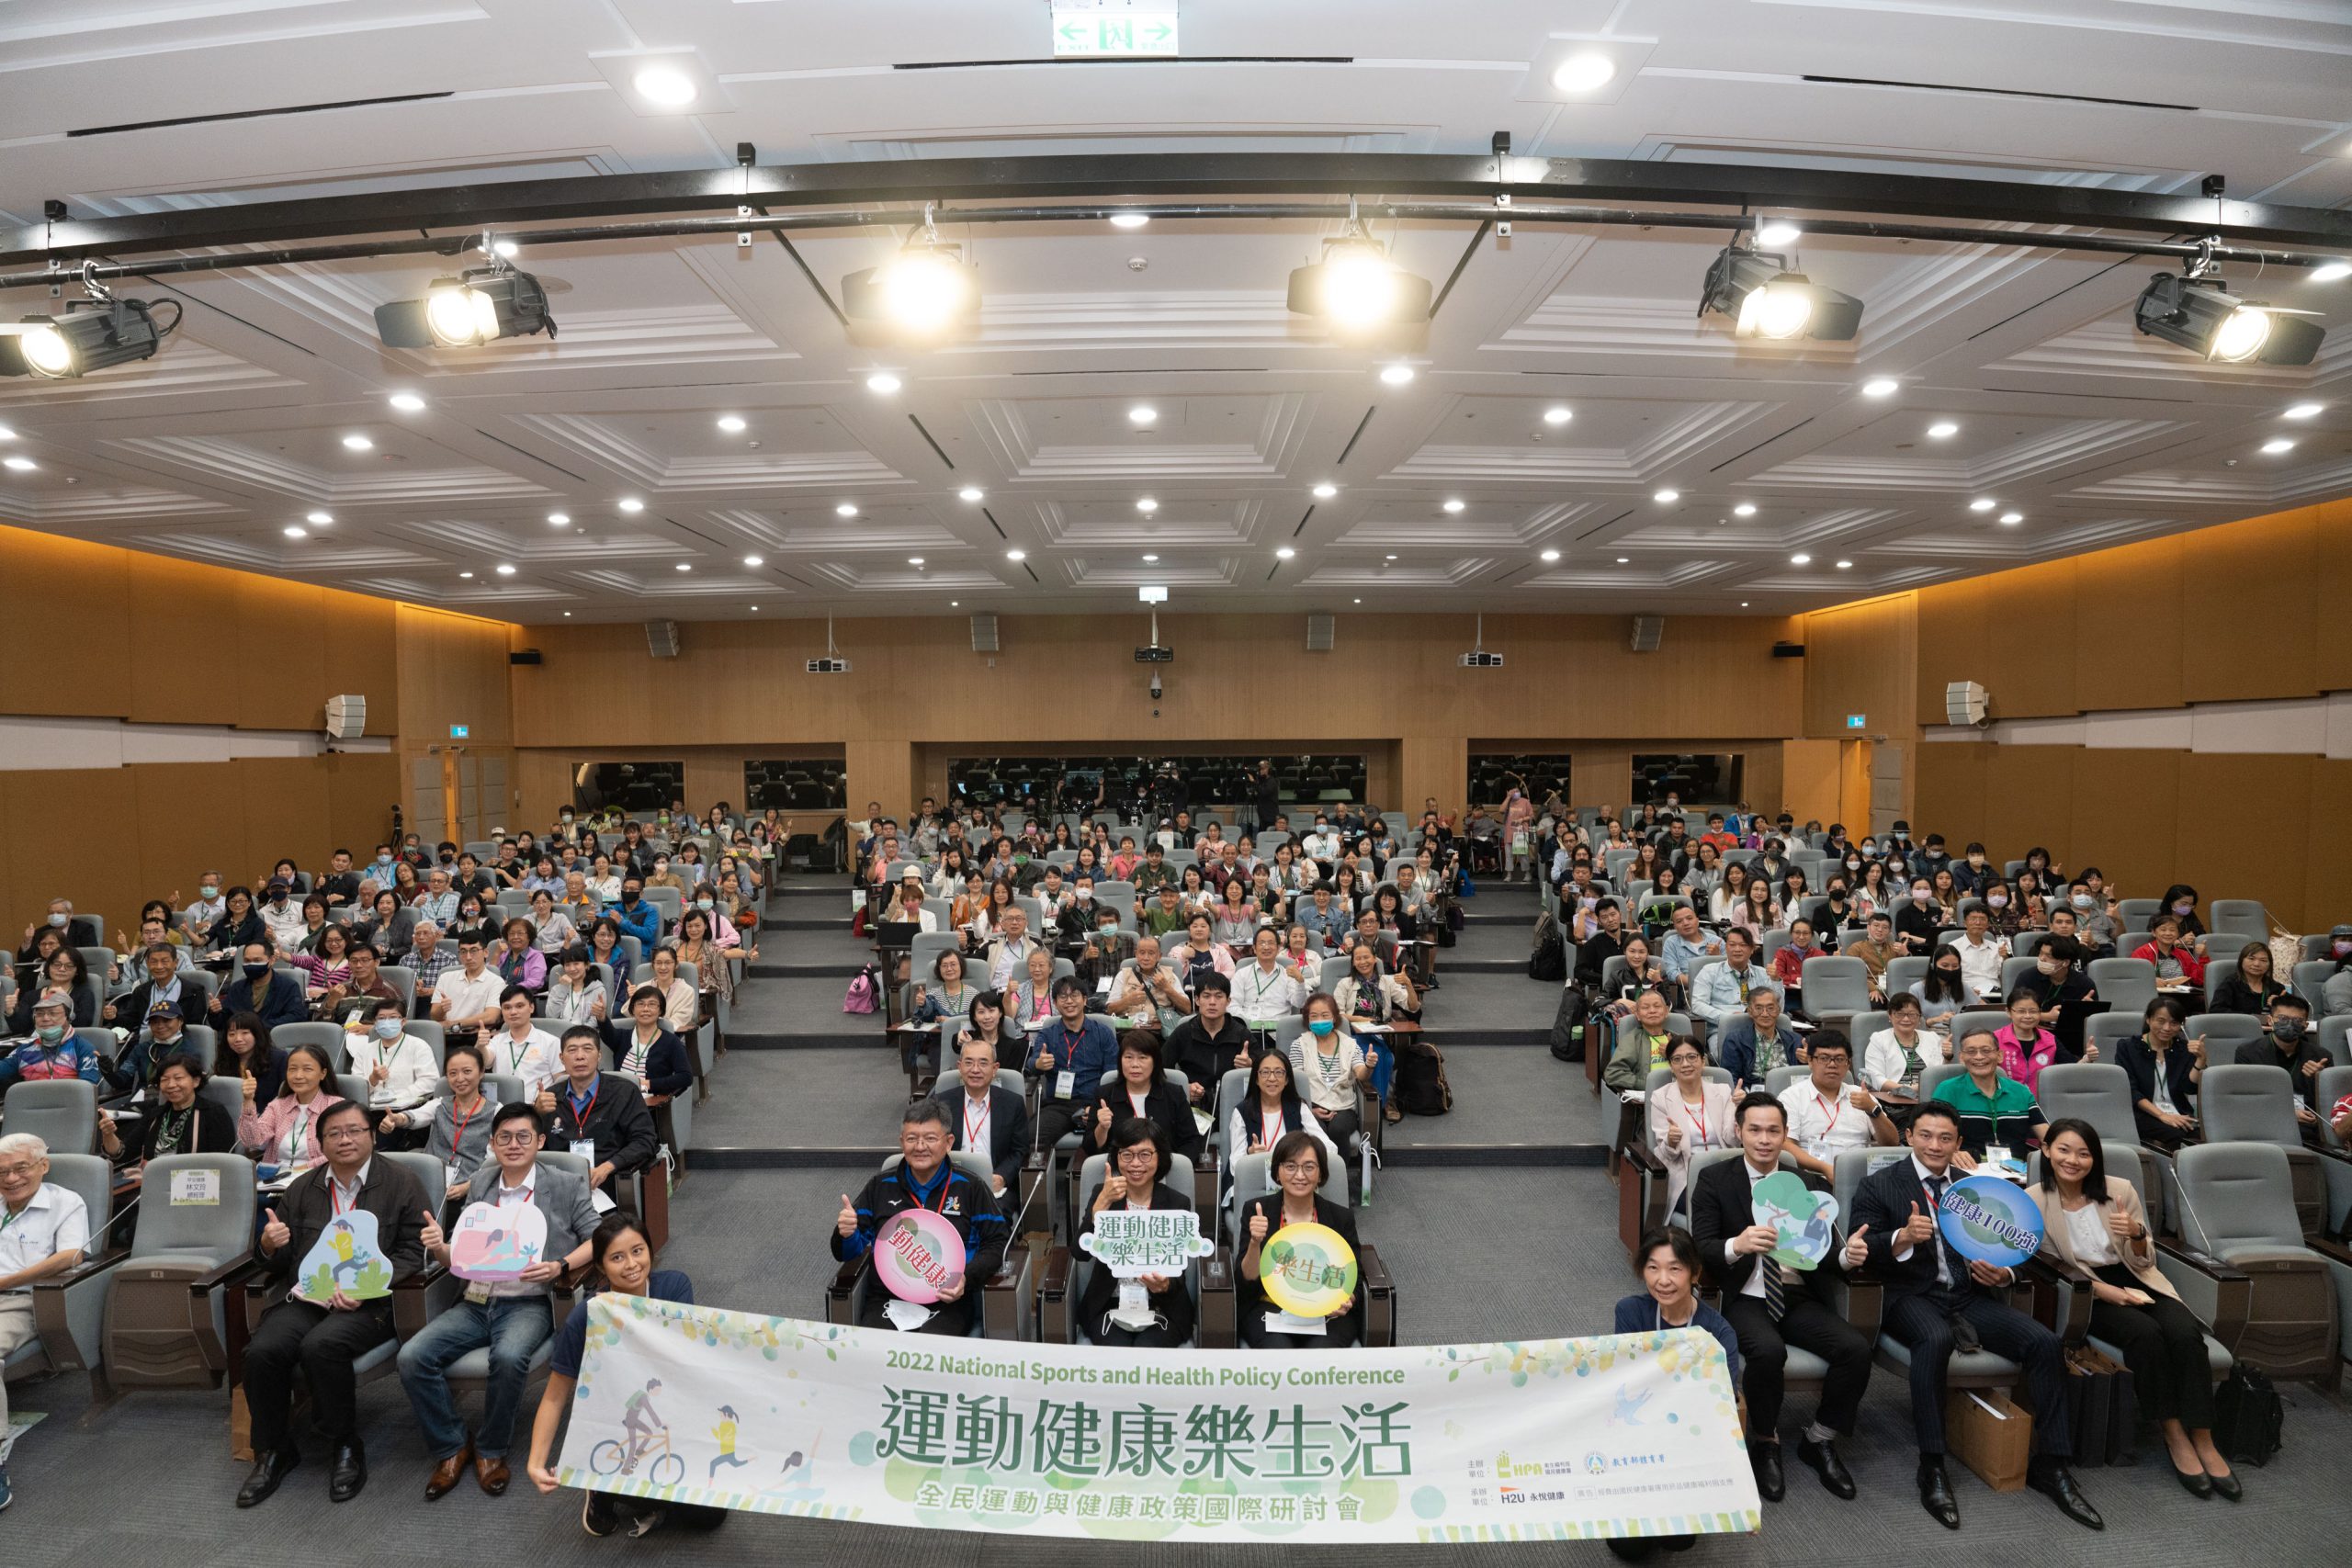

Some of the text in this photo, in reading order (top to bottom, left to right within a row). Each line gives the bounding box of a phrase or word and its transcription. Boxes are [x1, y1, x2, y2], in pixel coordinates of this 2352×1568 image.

[1099, 1215, 1194, 1239] 運動健康
[1943, 1192, 2038, 1253] 健康100強
[888, 1226, 949, 1289] 動健康
[1112, 1242, 1184, 1266] 樂生活
[1272, 1253, 1345, 1289] 樂生活
[886, 1349, 1405, 1390] 2022 National Sports and Health Policy Conference
[876, 1384, 1411, 1478] 運動健康樂生活
[1513, 1463, 1543, 1476] HPA
[917, 1484, 1361, 1521] 全民運動與健康政策國際研討會
[1501, 1494, 1525, 1504] H2U
[1530, 1492, 1565, 1501] 永悅健康
